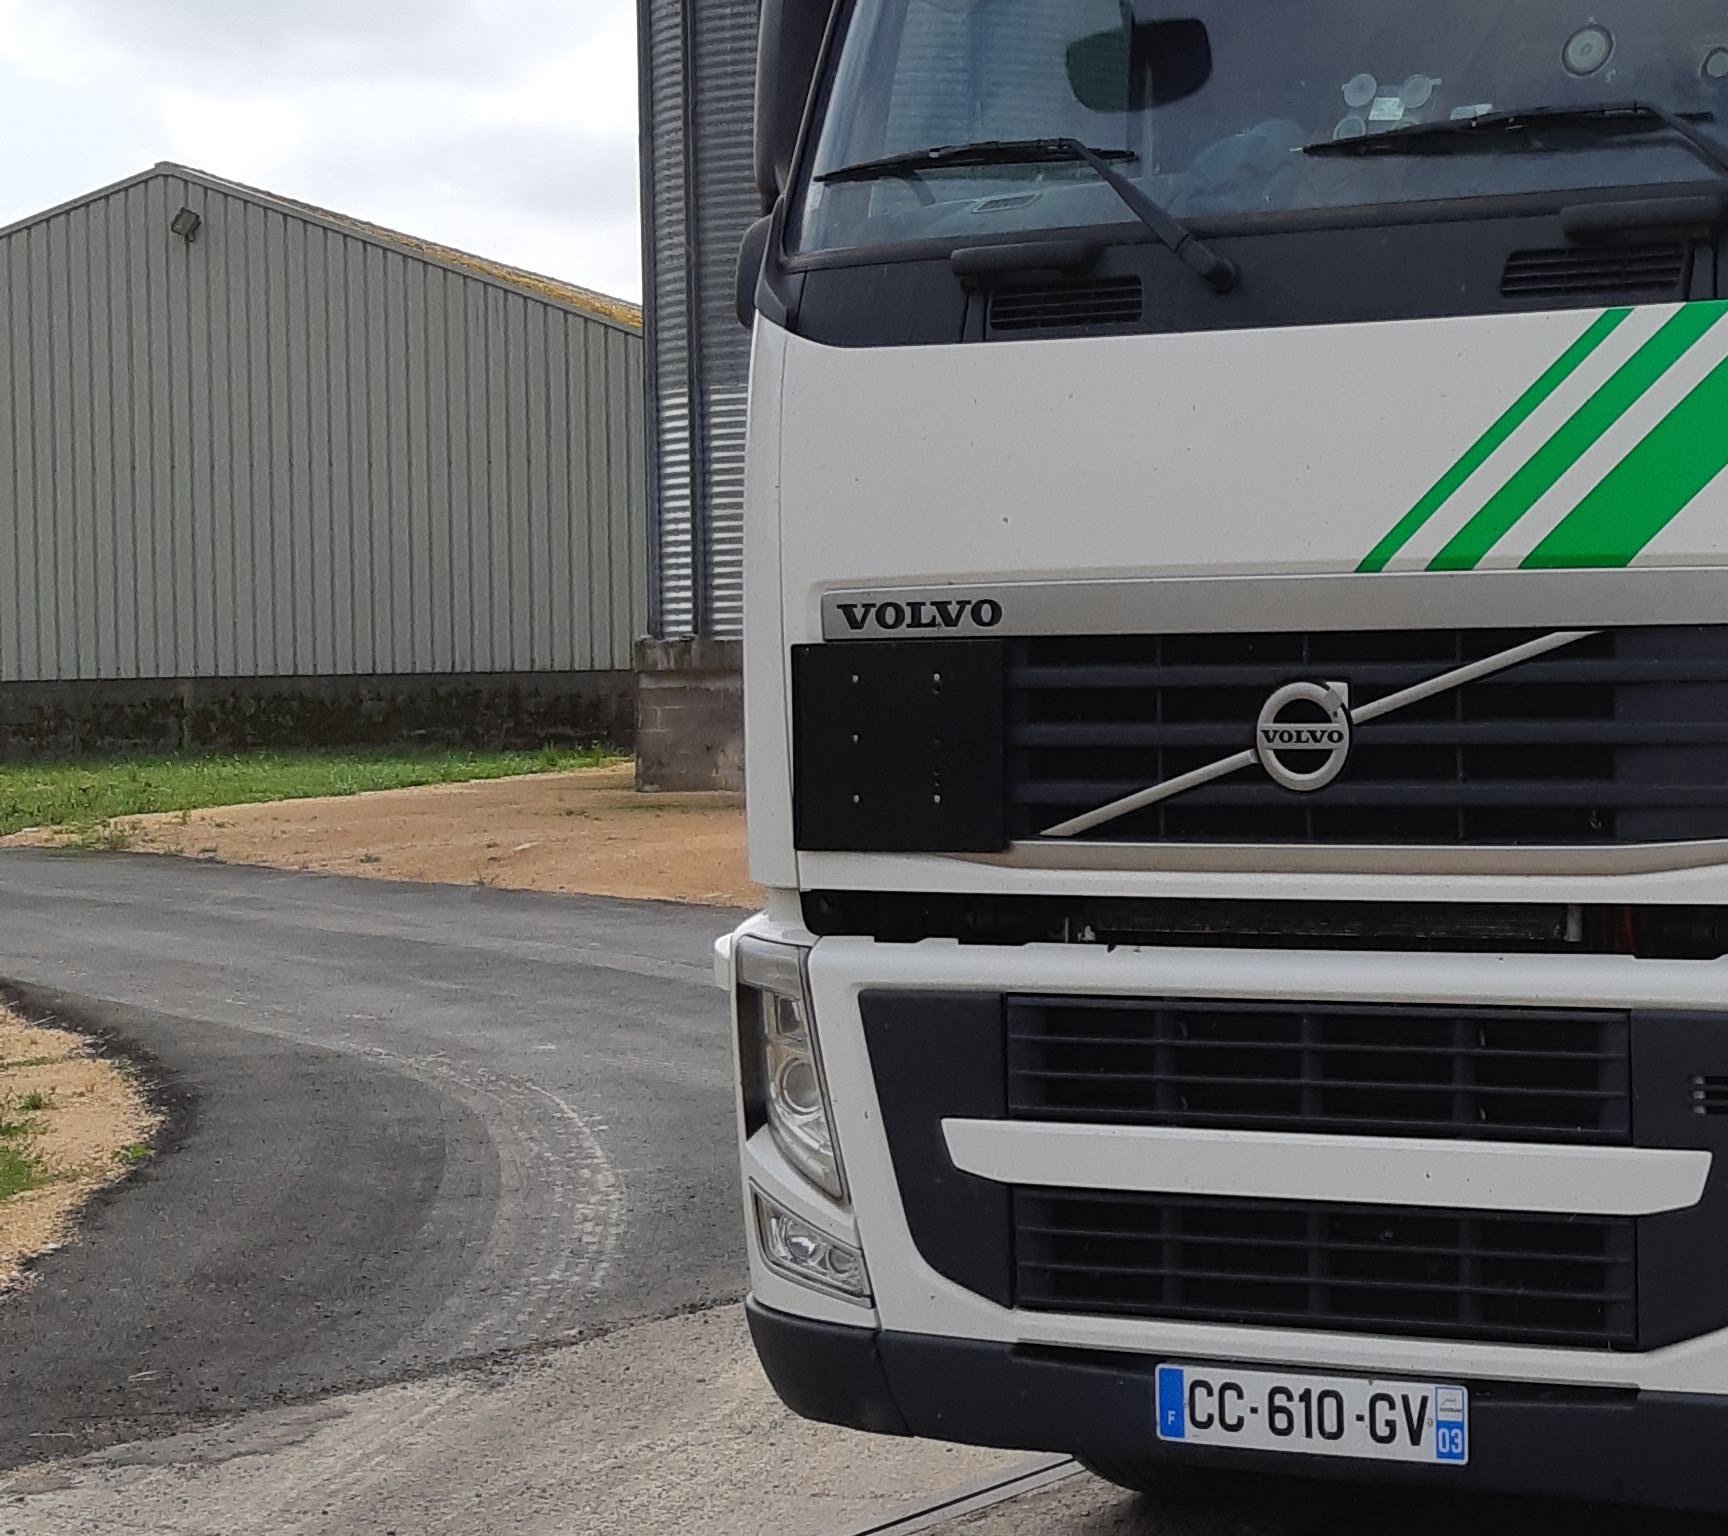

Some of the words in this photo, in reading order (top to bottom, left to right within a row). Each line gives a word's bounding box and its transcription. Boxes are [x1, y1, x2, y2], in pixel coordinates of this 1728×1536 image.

[836, 598, 1003, 630] VOLVO
[1260, 729, 1345, 744] VOLVO
[1167, 1410, 1176, 1425] F
[1187, 1379, 1430, 1447] CC-610-GV
[1438, 1427, 1463, 1454] 03
